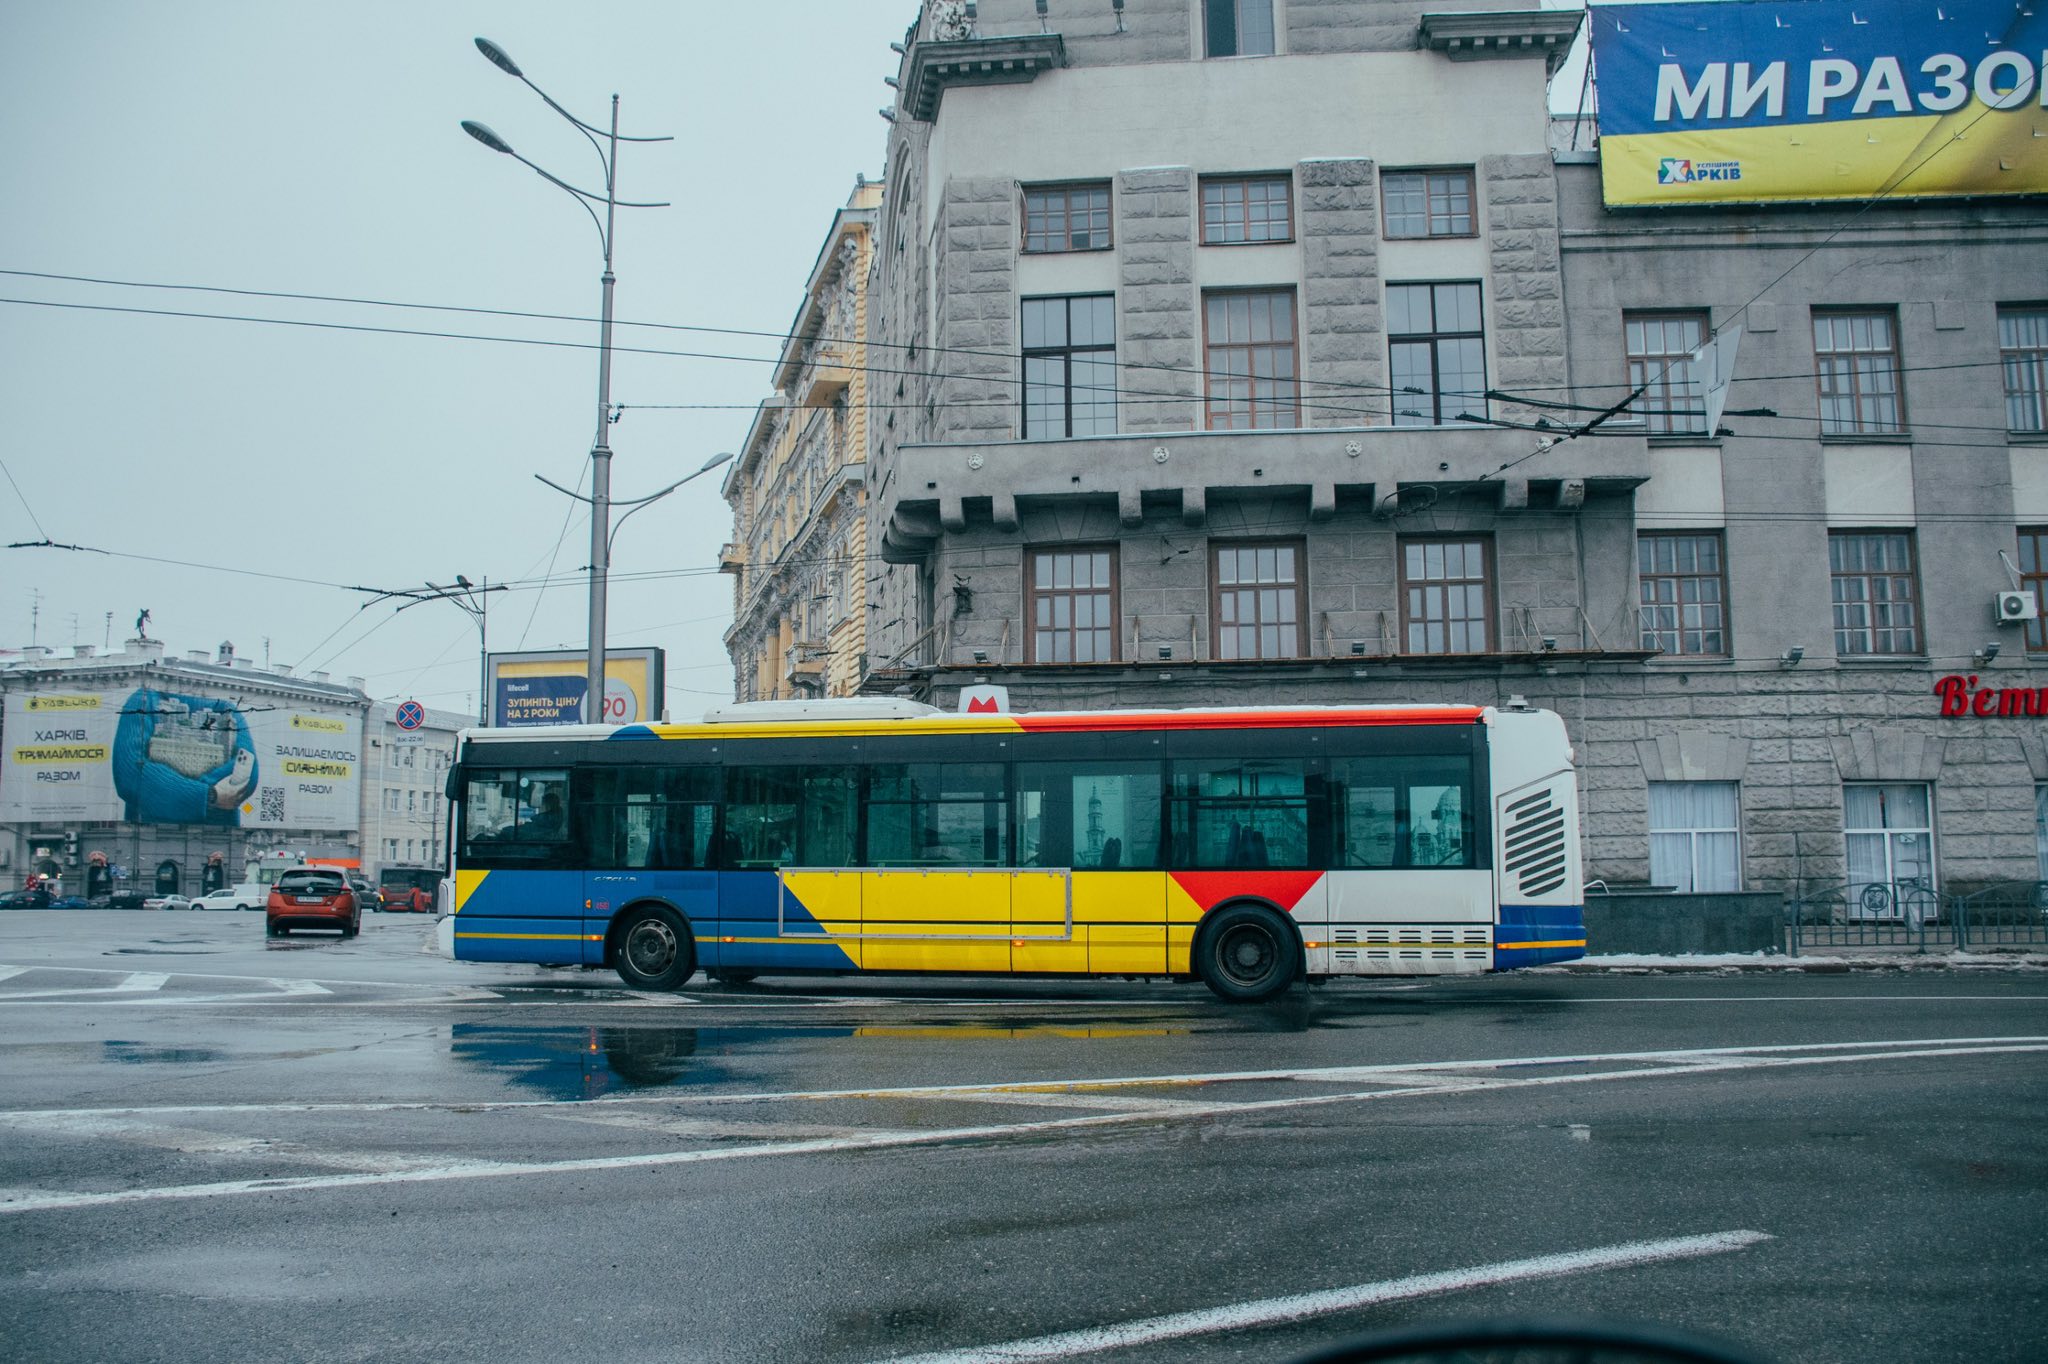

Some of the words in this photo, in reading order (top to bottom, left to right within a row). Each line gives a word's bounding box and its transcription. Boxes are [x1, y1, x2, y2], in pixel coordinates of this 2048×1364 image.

[1653, 61, 1786, 122] МИ
[1806, 49, 2048, 116] РАЗО
[1696, 161, 1739, 169] УСПІШНИЙ
[1661, 160, 1741, 182] ХАРКІВ
[507, 684, 530, 692] lifecell
[42, 699, 97, 708] YABLUKA
[507, 697, 553, 708] ЗУПИНІТЬ
[555, 697, 579, 708] ЦІНУ
[507, 709, 521, 719] НА
[523, 709, 530, 718] 2
[531, 709, 559, 718] РОКИ
[303, 719, 343, 731] YABLUKA
[18, 747, 104, 760] ТРИМАЙМОСЯ
[276, 745, 357, 761] ЗАЛИШАЄМОСЬ
[286, 762, 346, 777] СИЛЬНИМИ
[37, 771, 81, 781] РАЗОМ
[299, 784, 333, 794] РАЗОМ
